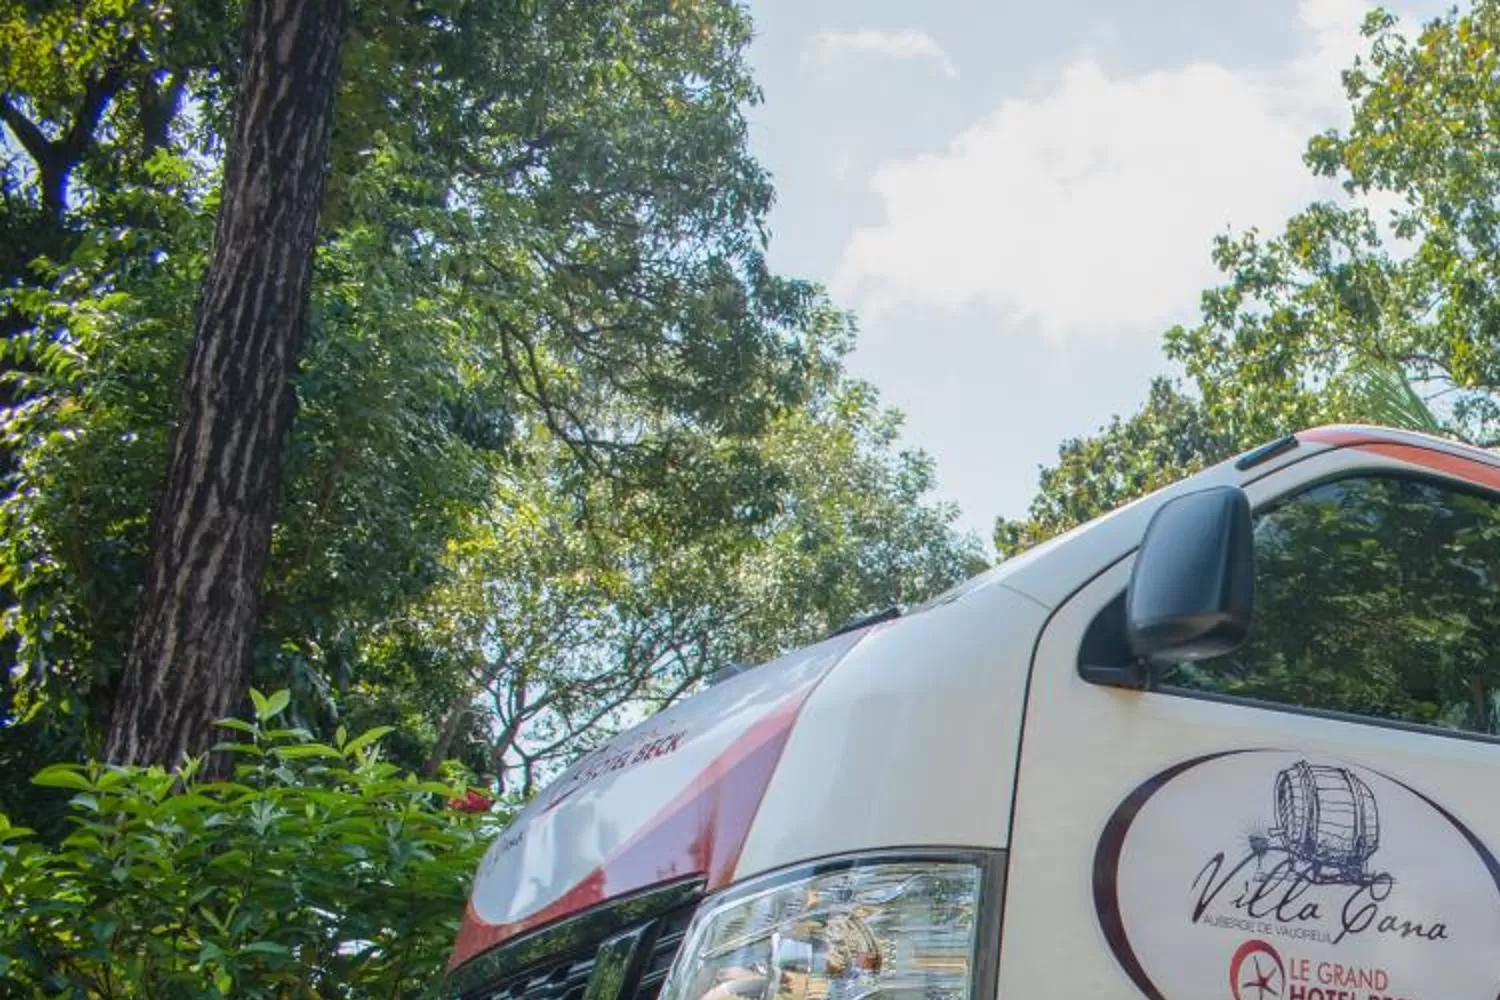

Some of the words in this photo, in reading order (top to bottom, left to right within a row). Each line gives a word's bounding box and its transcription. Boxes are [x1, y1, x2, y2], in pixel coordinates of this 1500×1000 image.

[1192, 848, 1321, 923] Villa
[1331, 872, 1449, 945] Cana
[1257, 922, 1273, 935] DE
[1289, 958, 1309, 981] LE
[1318, 962, 1389, 991] GRAND
